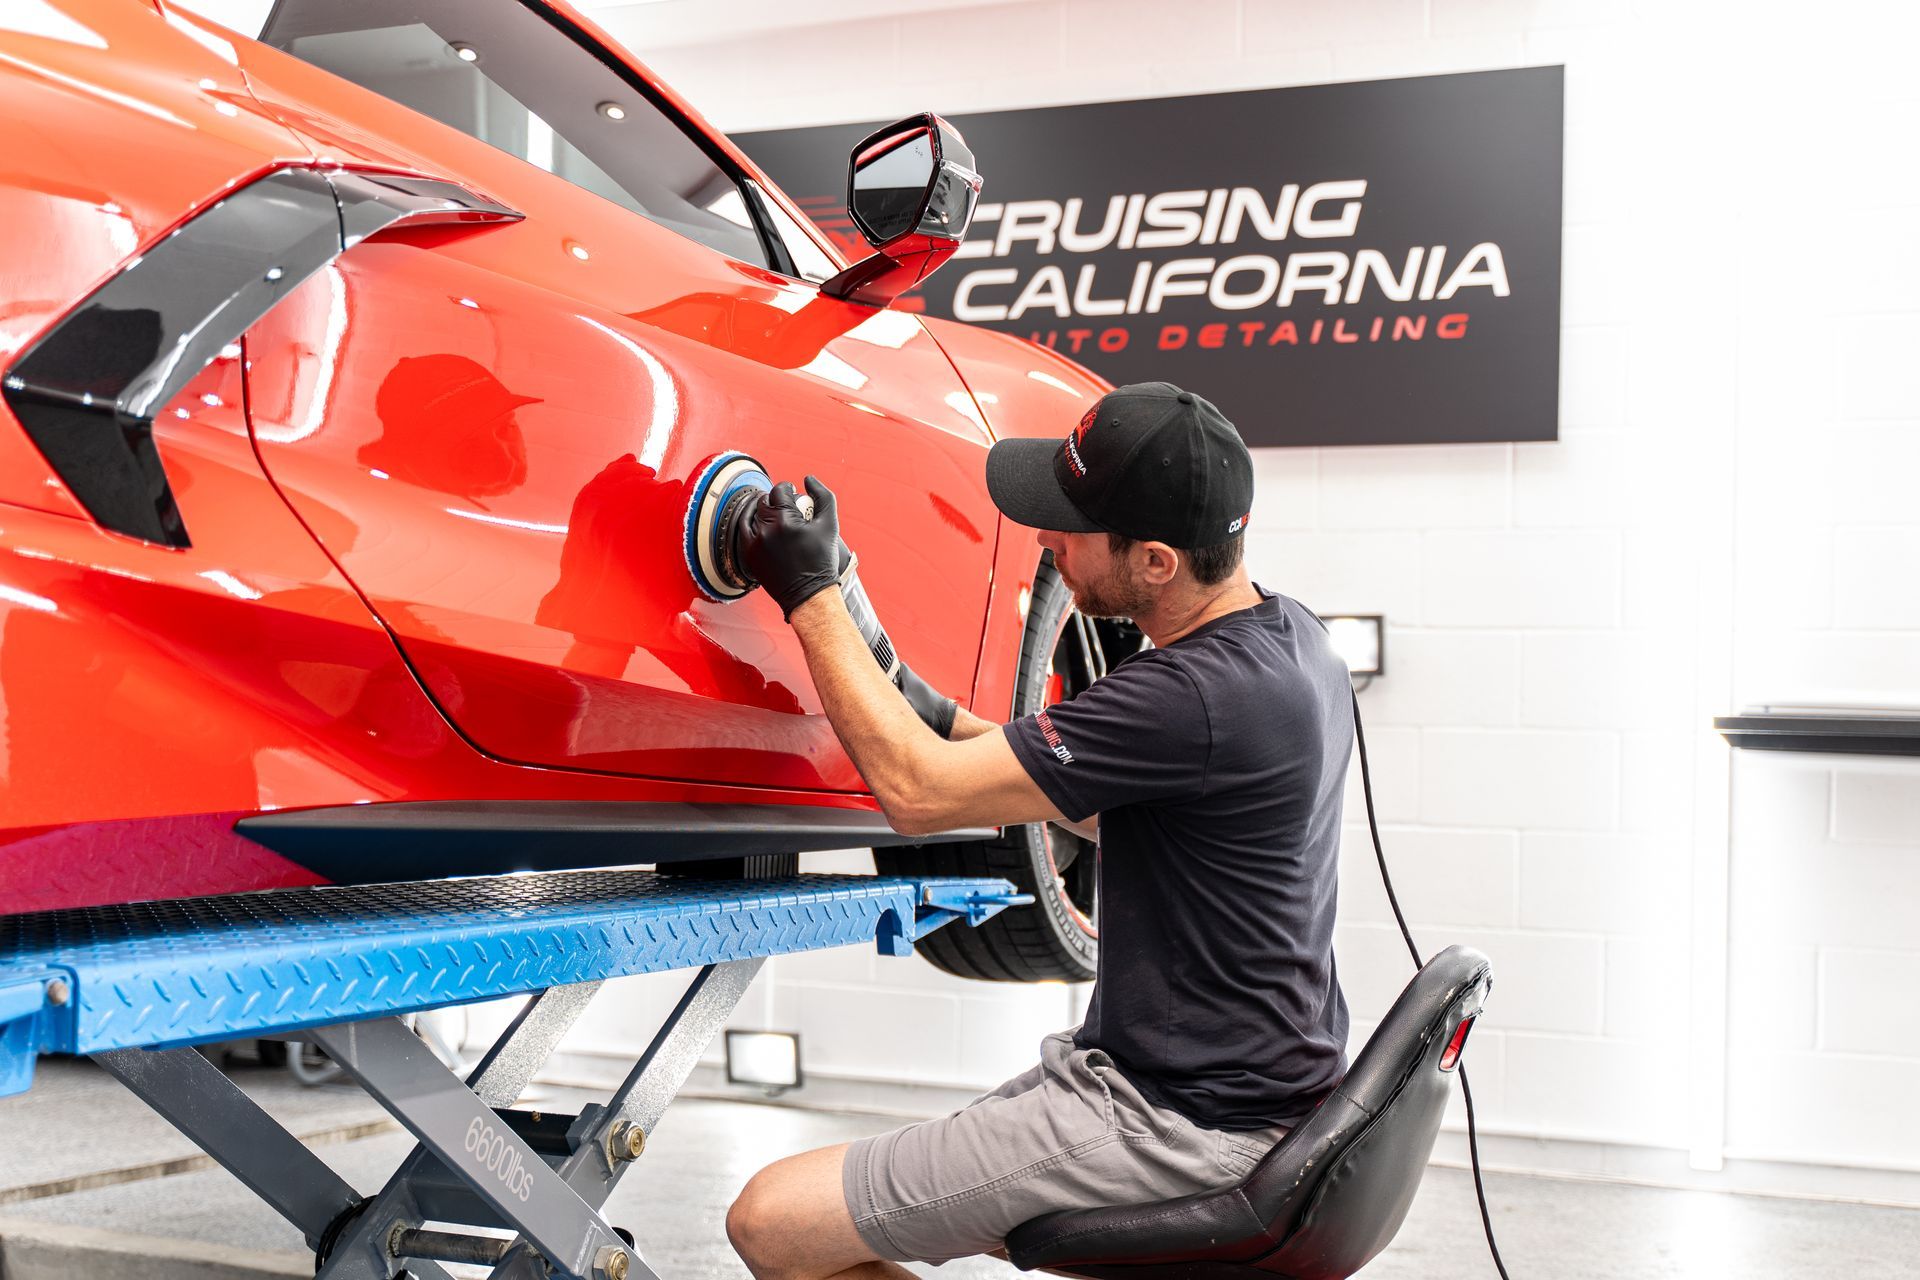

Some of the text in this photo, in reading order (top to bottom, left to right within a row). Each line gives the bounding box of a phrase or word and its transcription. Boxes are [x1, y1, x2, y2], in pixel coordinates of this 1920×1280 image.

[952, 180, 1367, 259] CRUISING
[953, 242, 1511, 322] CALIFORNIA
[1006, 313, 1470, 354] TO DETAILING
[1048, 889, 1085, 951] MICHELIN
[464, 1117, 533, 1201] 6600lbs
